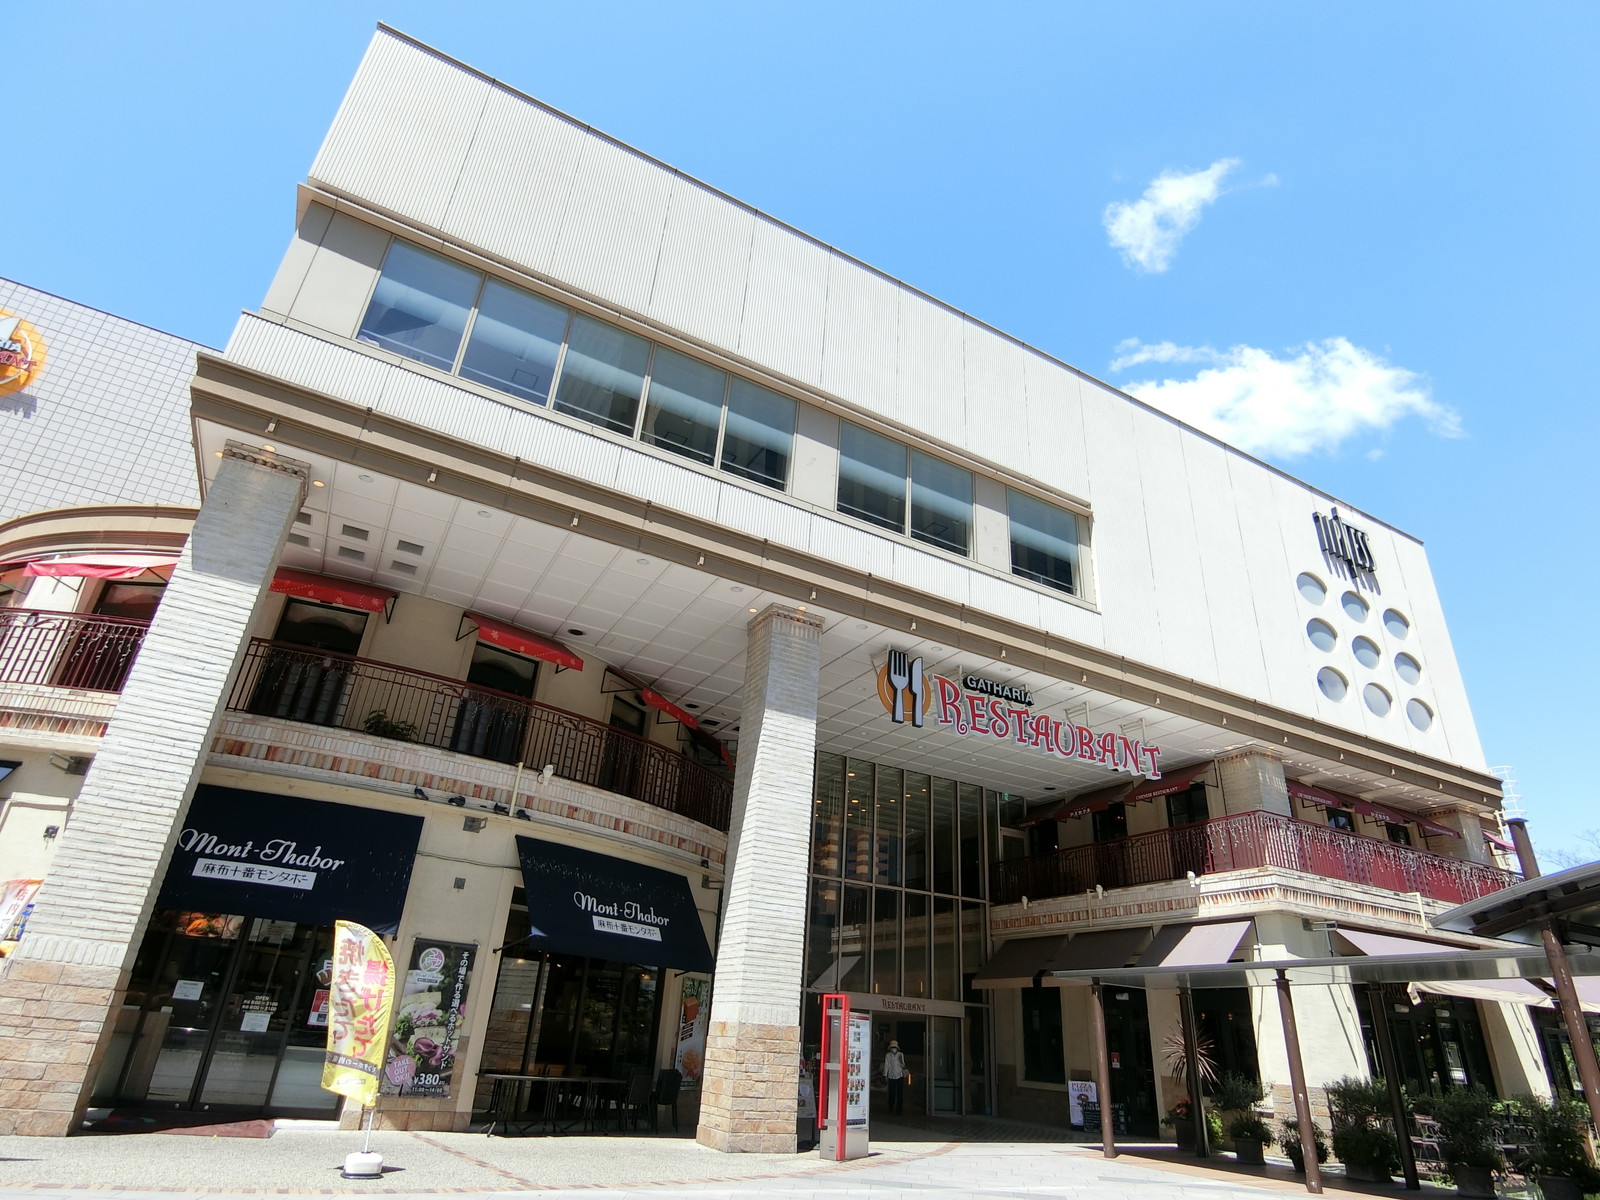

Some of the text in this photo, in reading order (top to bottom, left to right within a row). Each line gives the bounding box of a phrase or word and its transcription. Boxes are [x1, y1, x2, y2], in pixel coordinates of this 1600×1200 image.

[965, 675, 1034, 705] GATHARIA
[932, 673, 1162, 779] RESTAURANT
[178, 828, 345, 871] Mont-Thabor
[200, 861, 309, 885] 麻布十番モンタボー
[573, 891, 670, 926] Mont-Thabor
[882, 998, 926, 1012] RESTAURANT
[393, 1057, 411, 1069] TAKE
[394, 1065, 408, 1075] OUT
